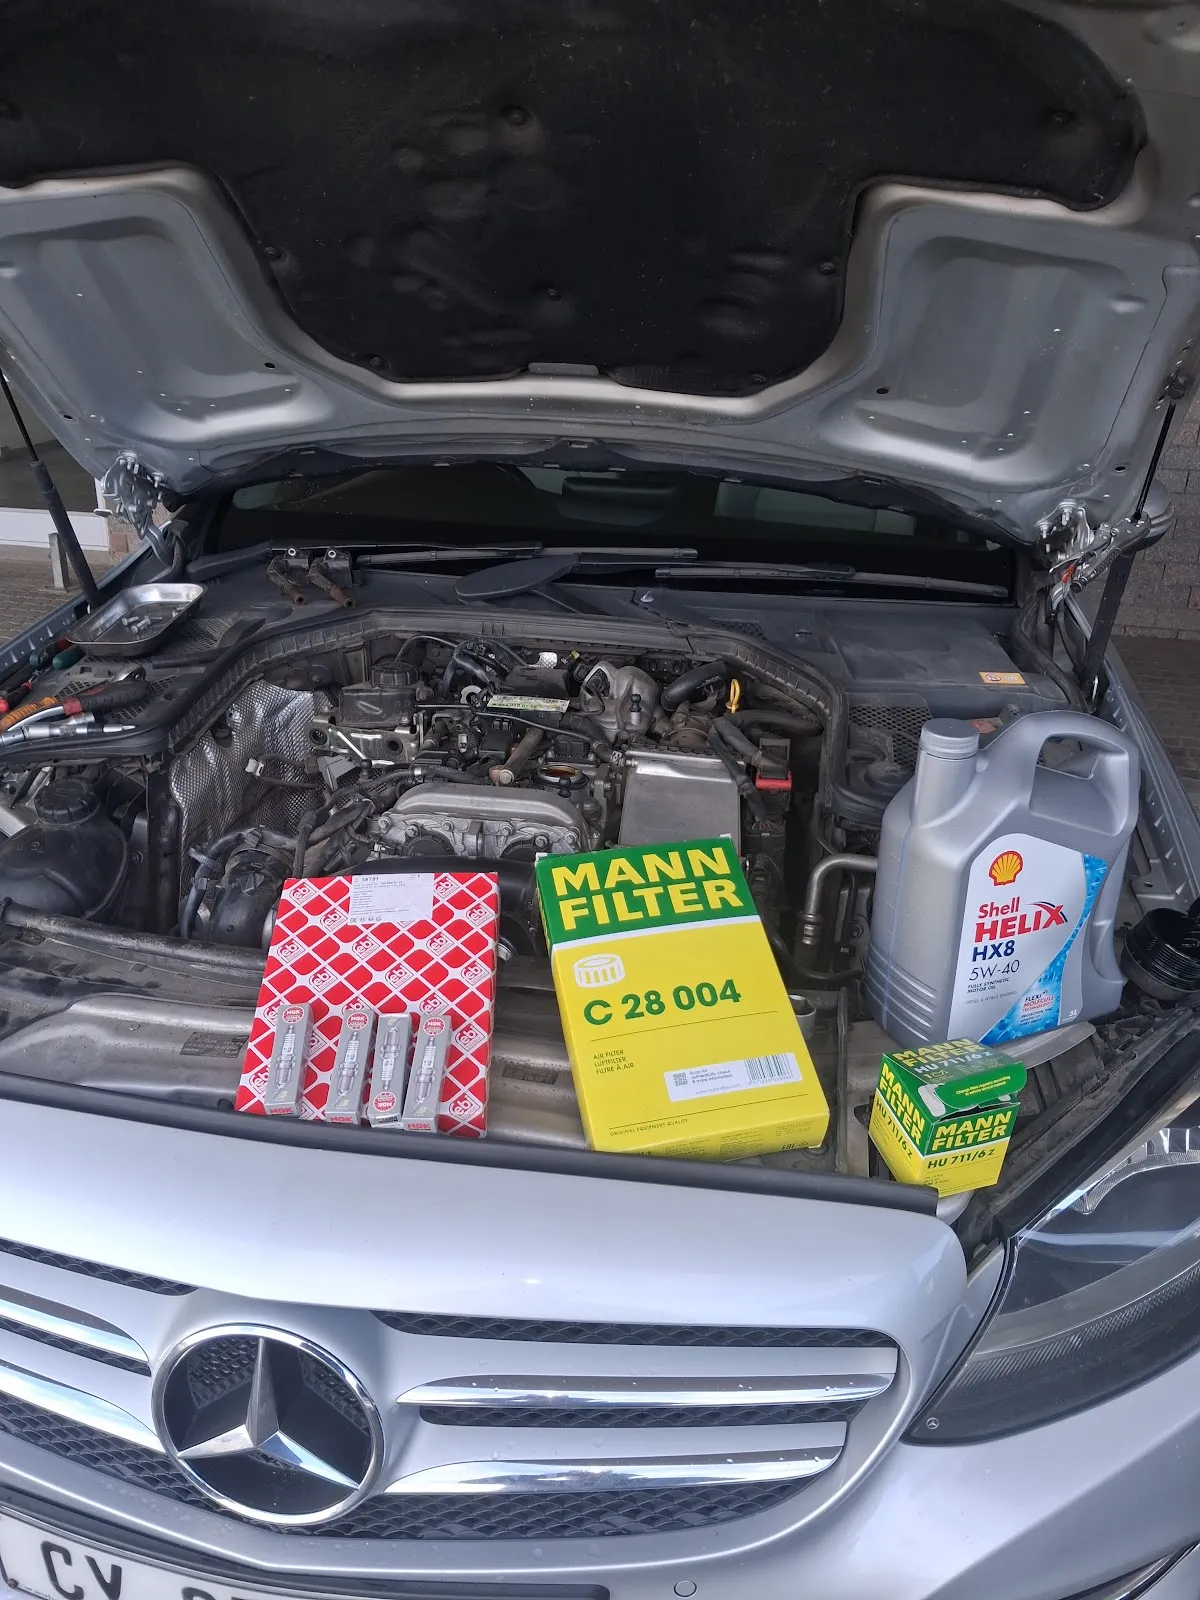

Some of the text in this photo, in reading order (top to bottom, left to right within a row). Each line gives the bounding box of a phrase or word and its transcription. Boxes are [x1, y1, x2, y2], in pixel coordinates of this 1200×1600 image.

[552, 847, 731, 896] MANN
[559, 879, 744, 931] FILTER
[978, 896, 1020, 919] Shell
[974, 902, 1066, 943] HELIX
[972, 940, 1015, 962] HX8
[969, 959, 1020, 981] 5W-40
[583, 979, 741, 1025] C 28 004
[605, 1049, 624, 1058] FILTER
[892, 1038, 974, 1060] MANN
[901, 1044, 985, 1067] FILTER
[596, 1065, 615, 1075] FILTRE
[914, 1063, 939, 1073] HU
[938, 1053, 982, 1066] 711/6
[876, 1098, 887, 1117] HU
[881, 1062, 925, 1133] MANN
[880, 1076, 922, 1145] FILTER
[935, 1111, 1012, 1138] MANN
[932, 1124, 1008, 1151] FILTER
[927, 1157, 948, 1169] HU
[951, 1149, 986, 1164] 711/6
